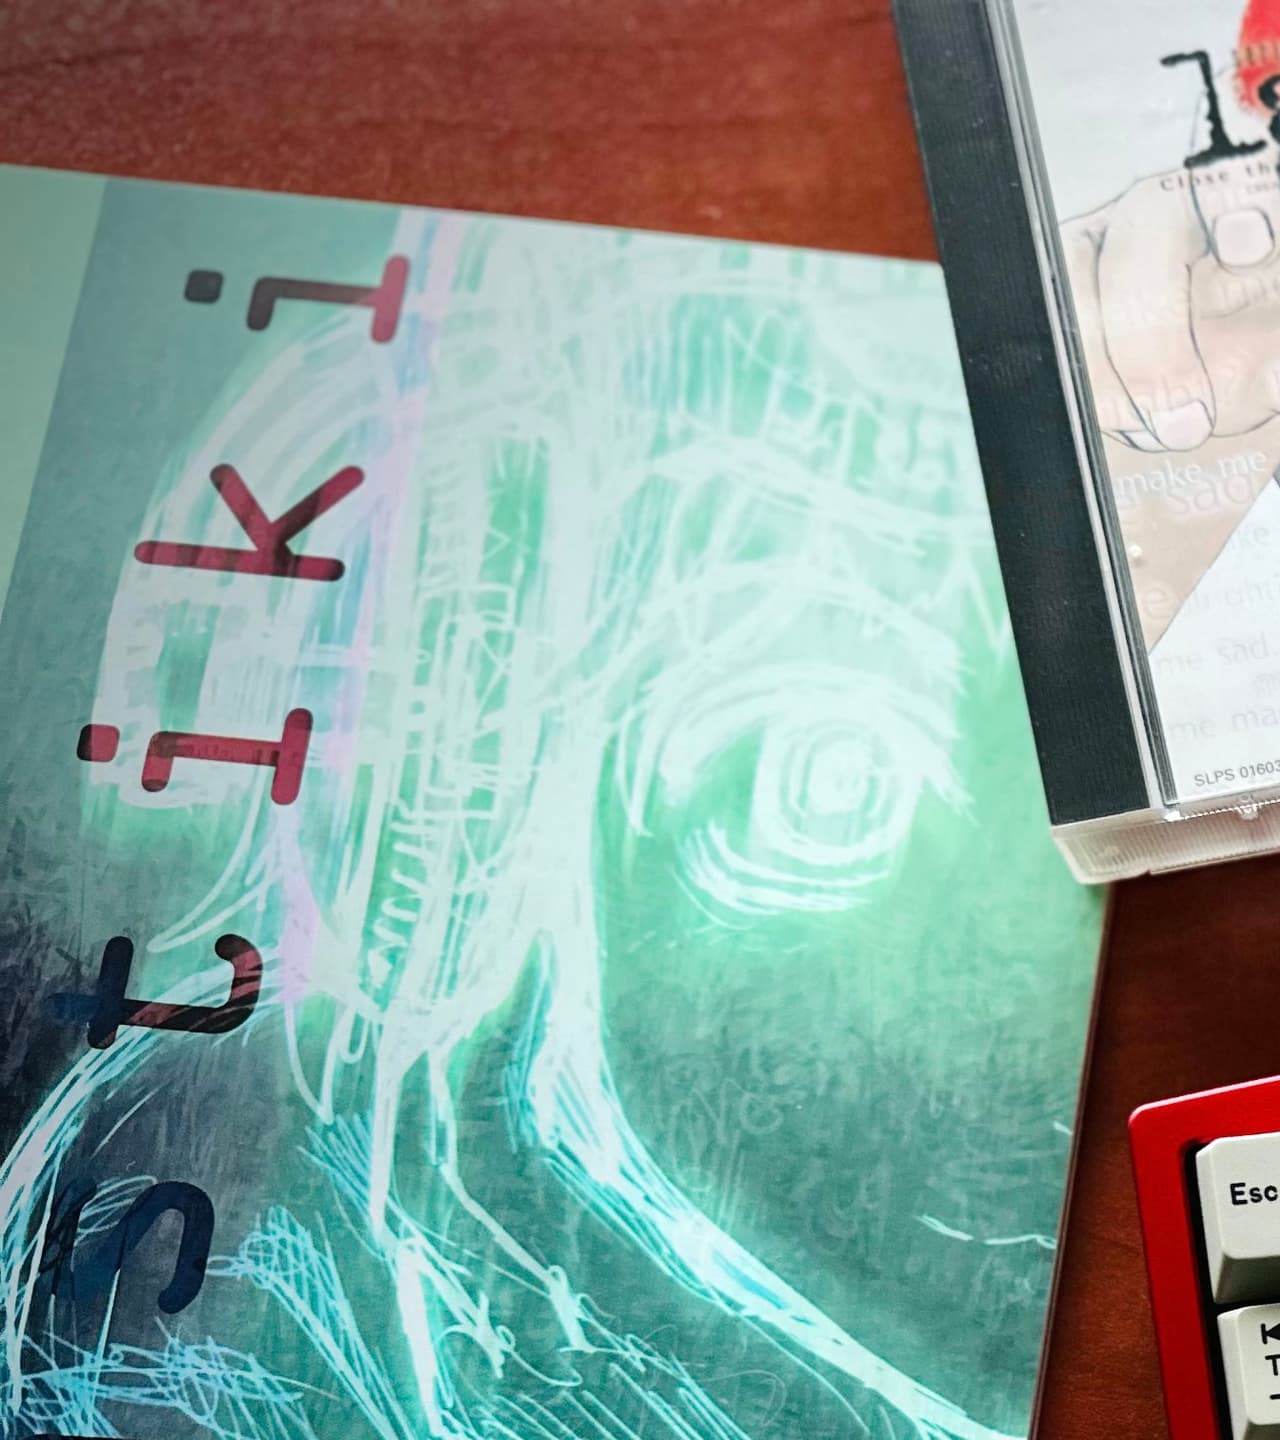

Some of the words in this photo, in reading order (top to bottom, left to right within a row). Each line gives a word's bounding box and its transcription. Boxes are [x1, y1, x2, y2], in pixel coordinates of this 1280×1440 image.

[1115, 459, 1202, 494] make
[1218, 453, 1268, 479] me
[1194, 768, 1236, 789] SLPS
[1229, 1182, 1279, 1206] Esc
